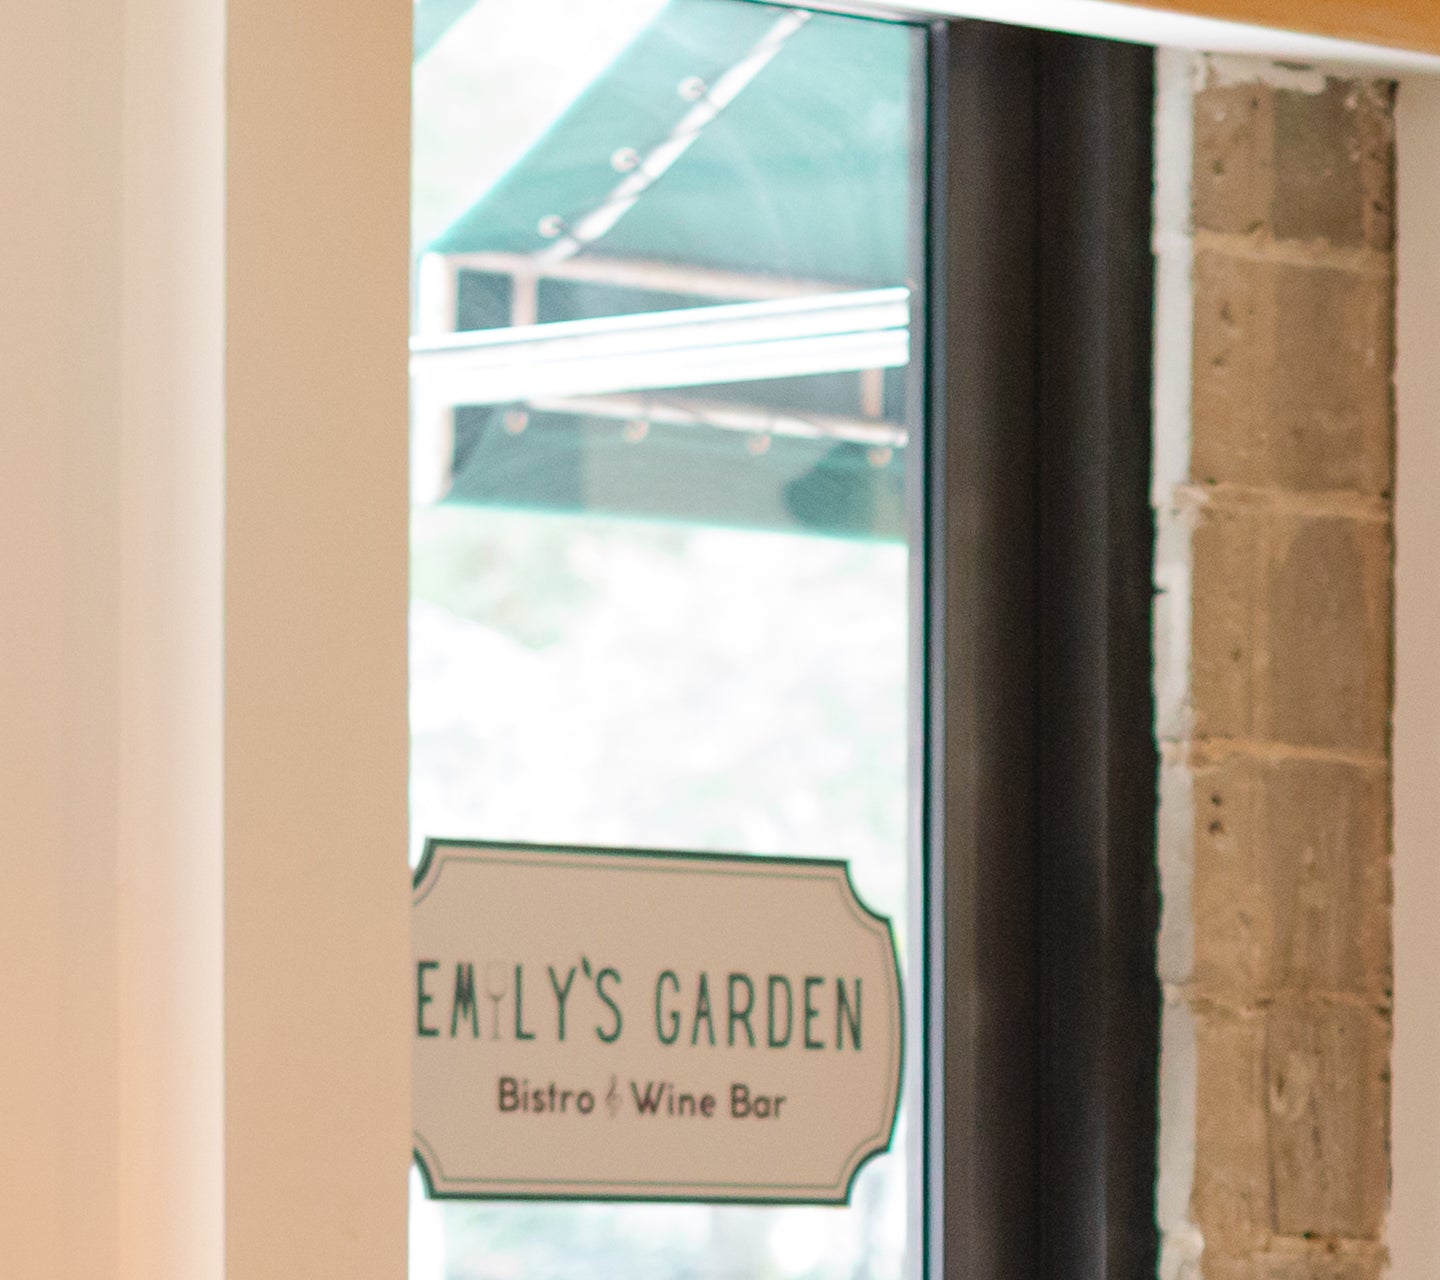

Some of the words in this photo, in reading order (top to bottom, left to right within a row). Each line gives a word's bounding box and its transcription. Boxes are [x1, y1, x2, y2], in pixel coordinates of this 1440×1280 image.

[655, 969, 862, 1051] GARDEN
[497, 1075, 596, 1115] Bistro
[629, 1079, 717, 1118] Wine
[729, 1082, 788, 1119] Bar
